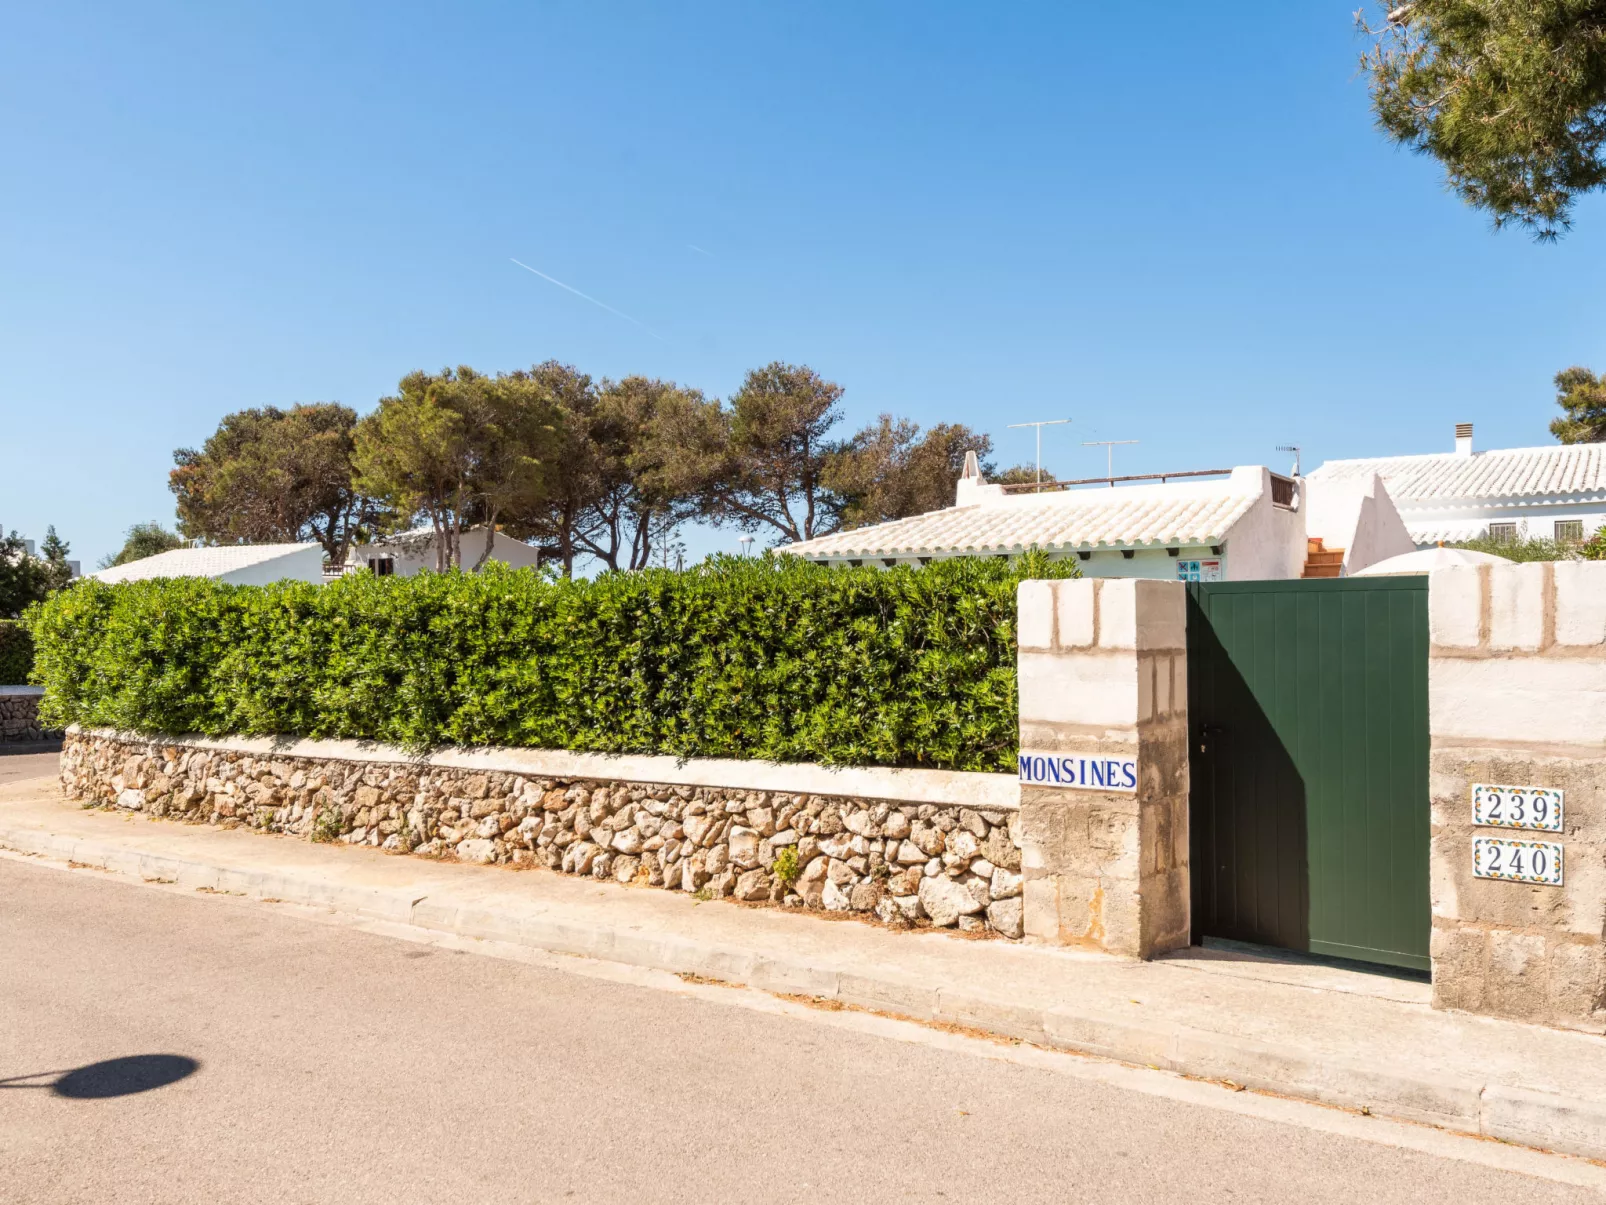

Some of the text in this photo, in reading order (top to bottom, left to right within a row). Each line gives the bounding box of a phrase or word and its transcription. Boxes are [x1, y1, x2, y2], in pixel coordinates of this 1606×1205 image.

[1019, 756, 1136, 788] MONSINES
[1487, 793, 1548, 822] 239
[1487, 846, 1547, 875] 240
